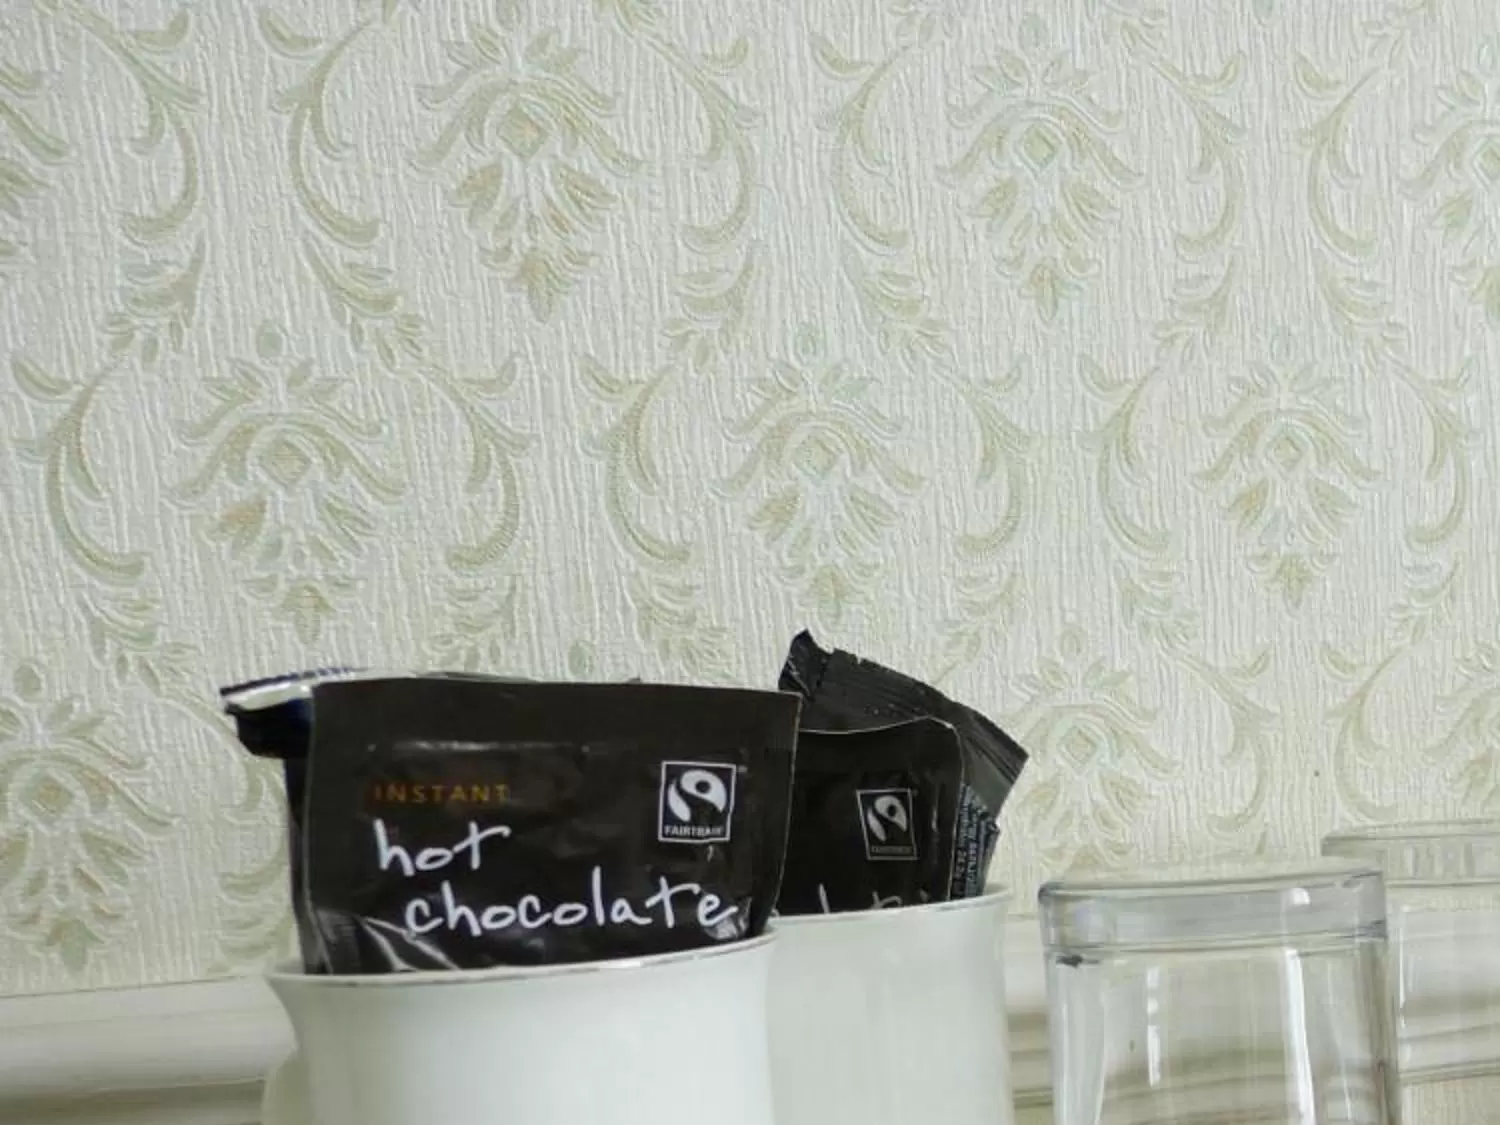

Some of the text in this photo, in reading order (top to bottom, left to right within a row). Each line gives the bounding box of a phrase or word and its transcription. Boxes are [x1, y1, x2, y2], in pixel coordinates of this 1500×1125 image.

[374, 783, 508, 803] INSTANT
[373, 818, 512, 878] hot
[405, 865, 739, 938] chocolate
